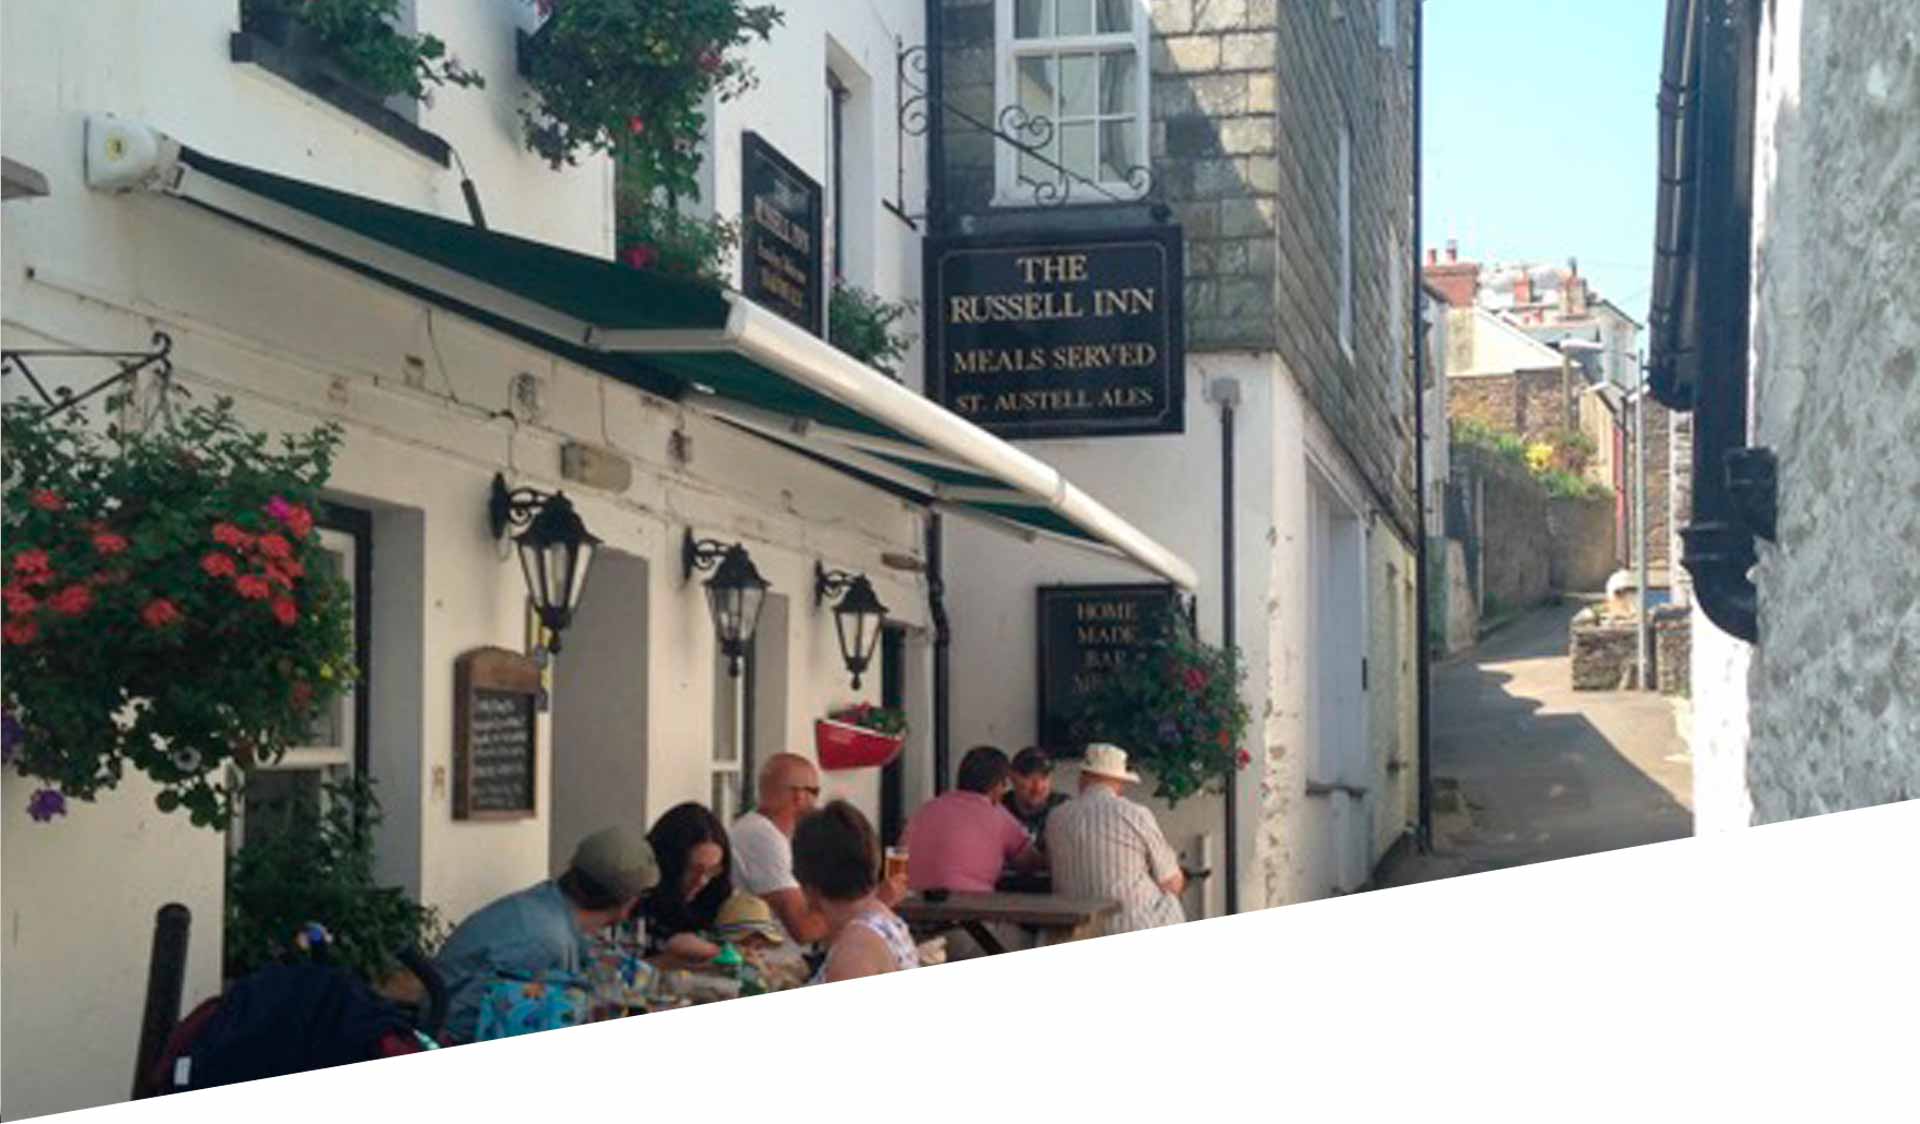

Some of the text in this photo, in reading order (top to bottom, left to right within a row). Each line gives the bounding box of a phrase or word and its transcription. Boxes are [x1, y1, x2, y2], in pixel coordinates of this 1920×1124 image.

[1017, 254, 1088, 284] THE
[951, 288, 1155, 323] RUSSELL INN
[953, 342, 1157, 373] MEALS SERVED
[957, 386, 1153, 413] ST. AUSTELL ALES
[1077, 602, 1136, 620] HOME
